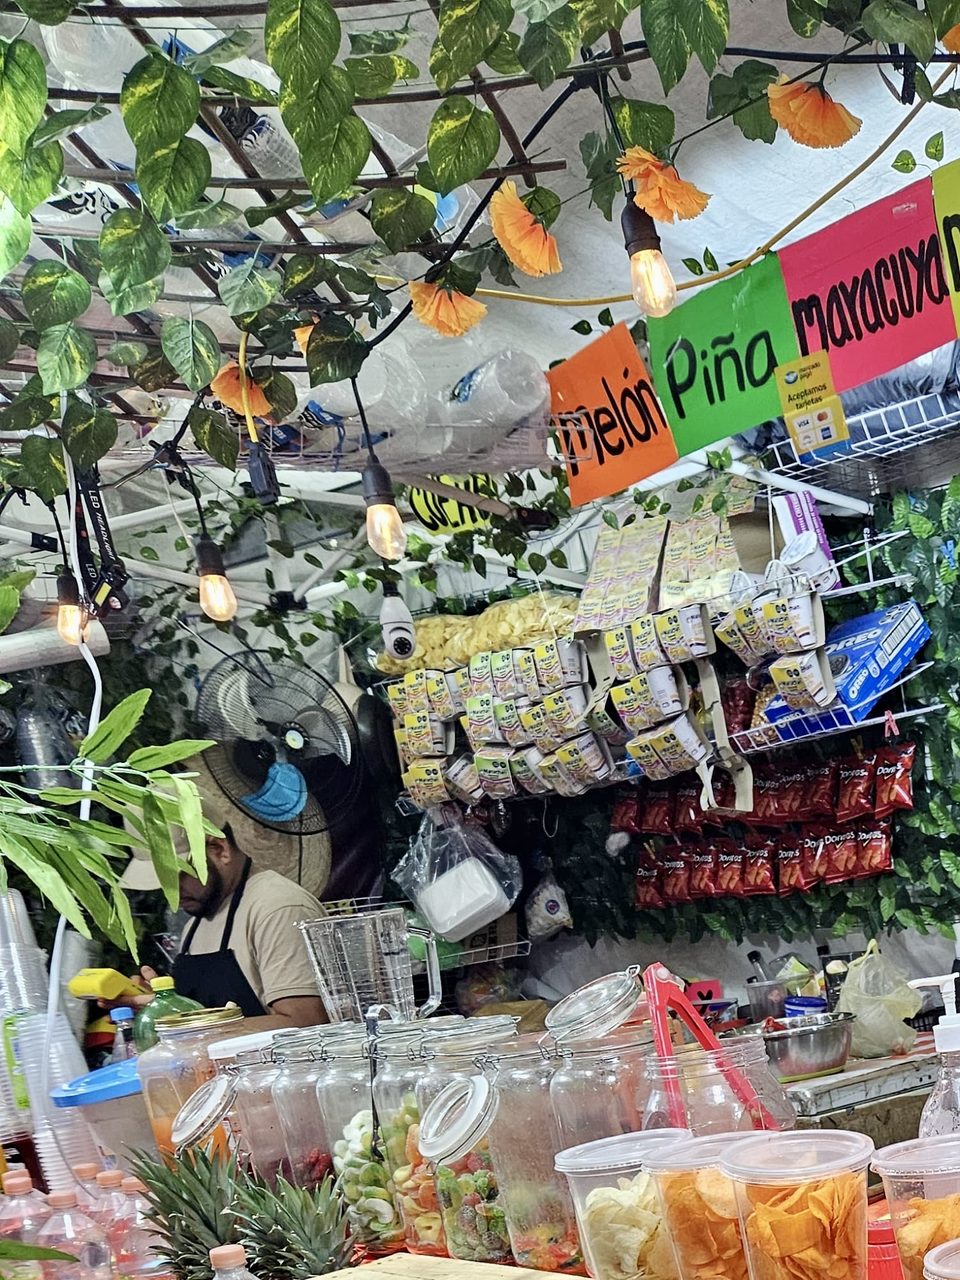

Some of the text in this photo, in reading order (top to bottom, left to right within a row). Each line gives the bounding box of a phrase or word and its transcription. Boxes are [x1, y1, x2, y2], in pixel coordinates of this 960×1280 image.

[667, 331, 780, 420] Piña
[788, 383, 827, 403] Aceptamos
[796, 396, 823, 411] tarjetas
[556, 368, 668, 477] melón
[849, 669, 869, 699] OREO
[825, 831, 855, 844] Doritos
